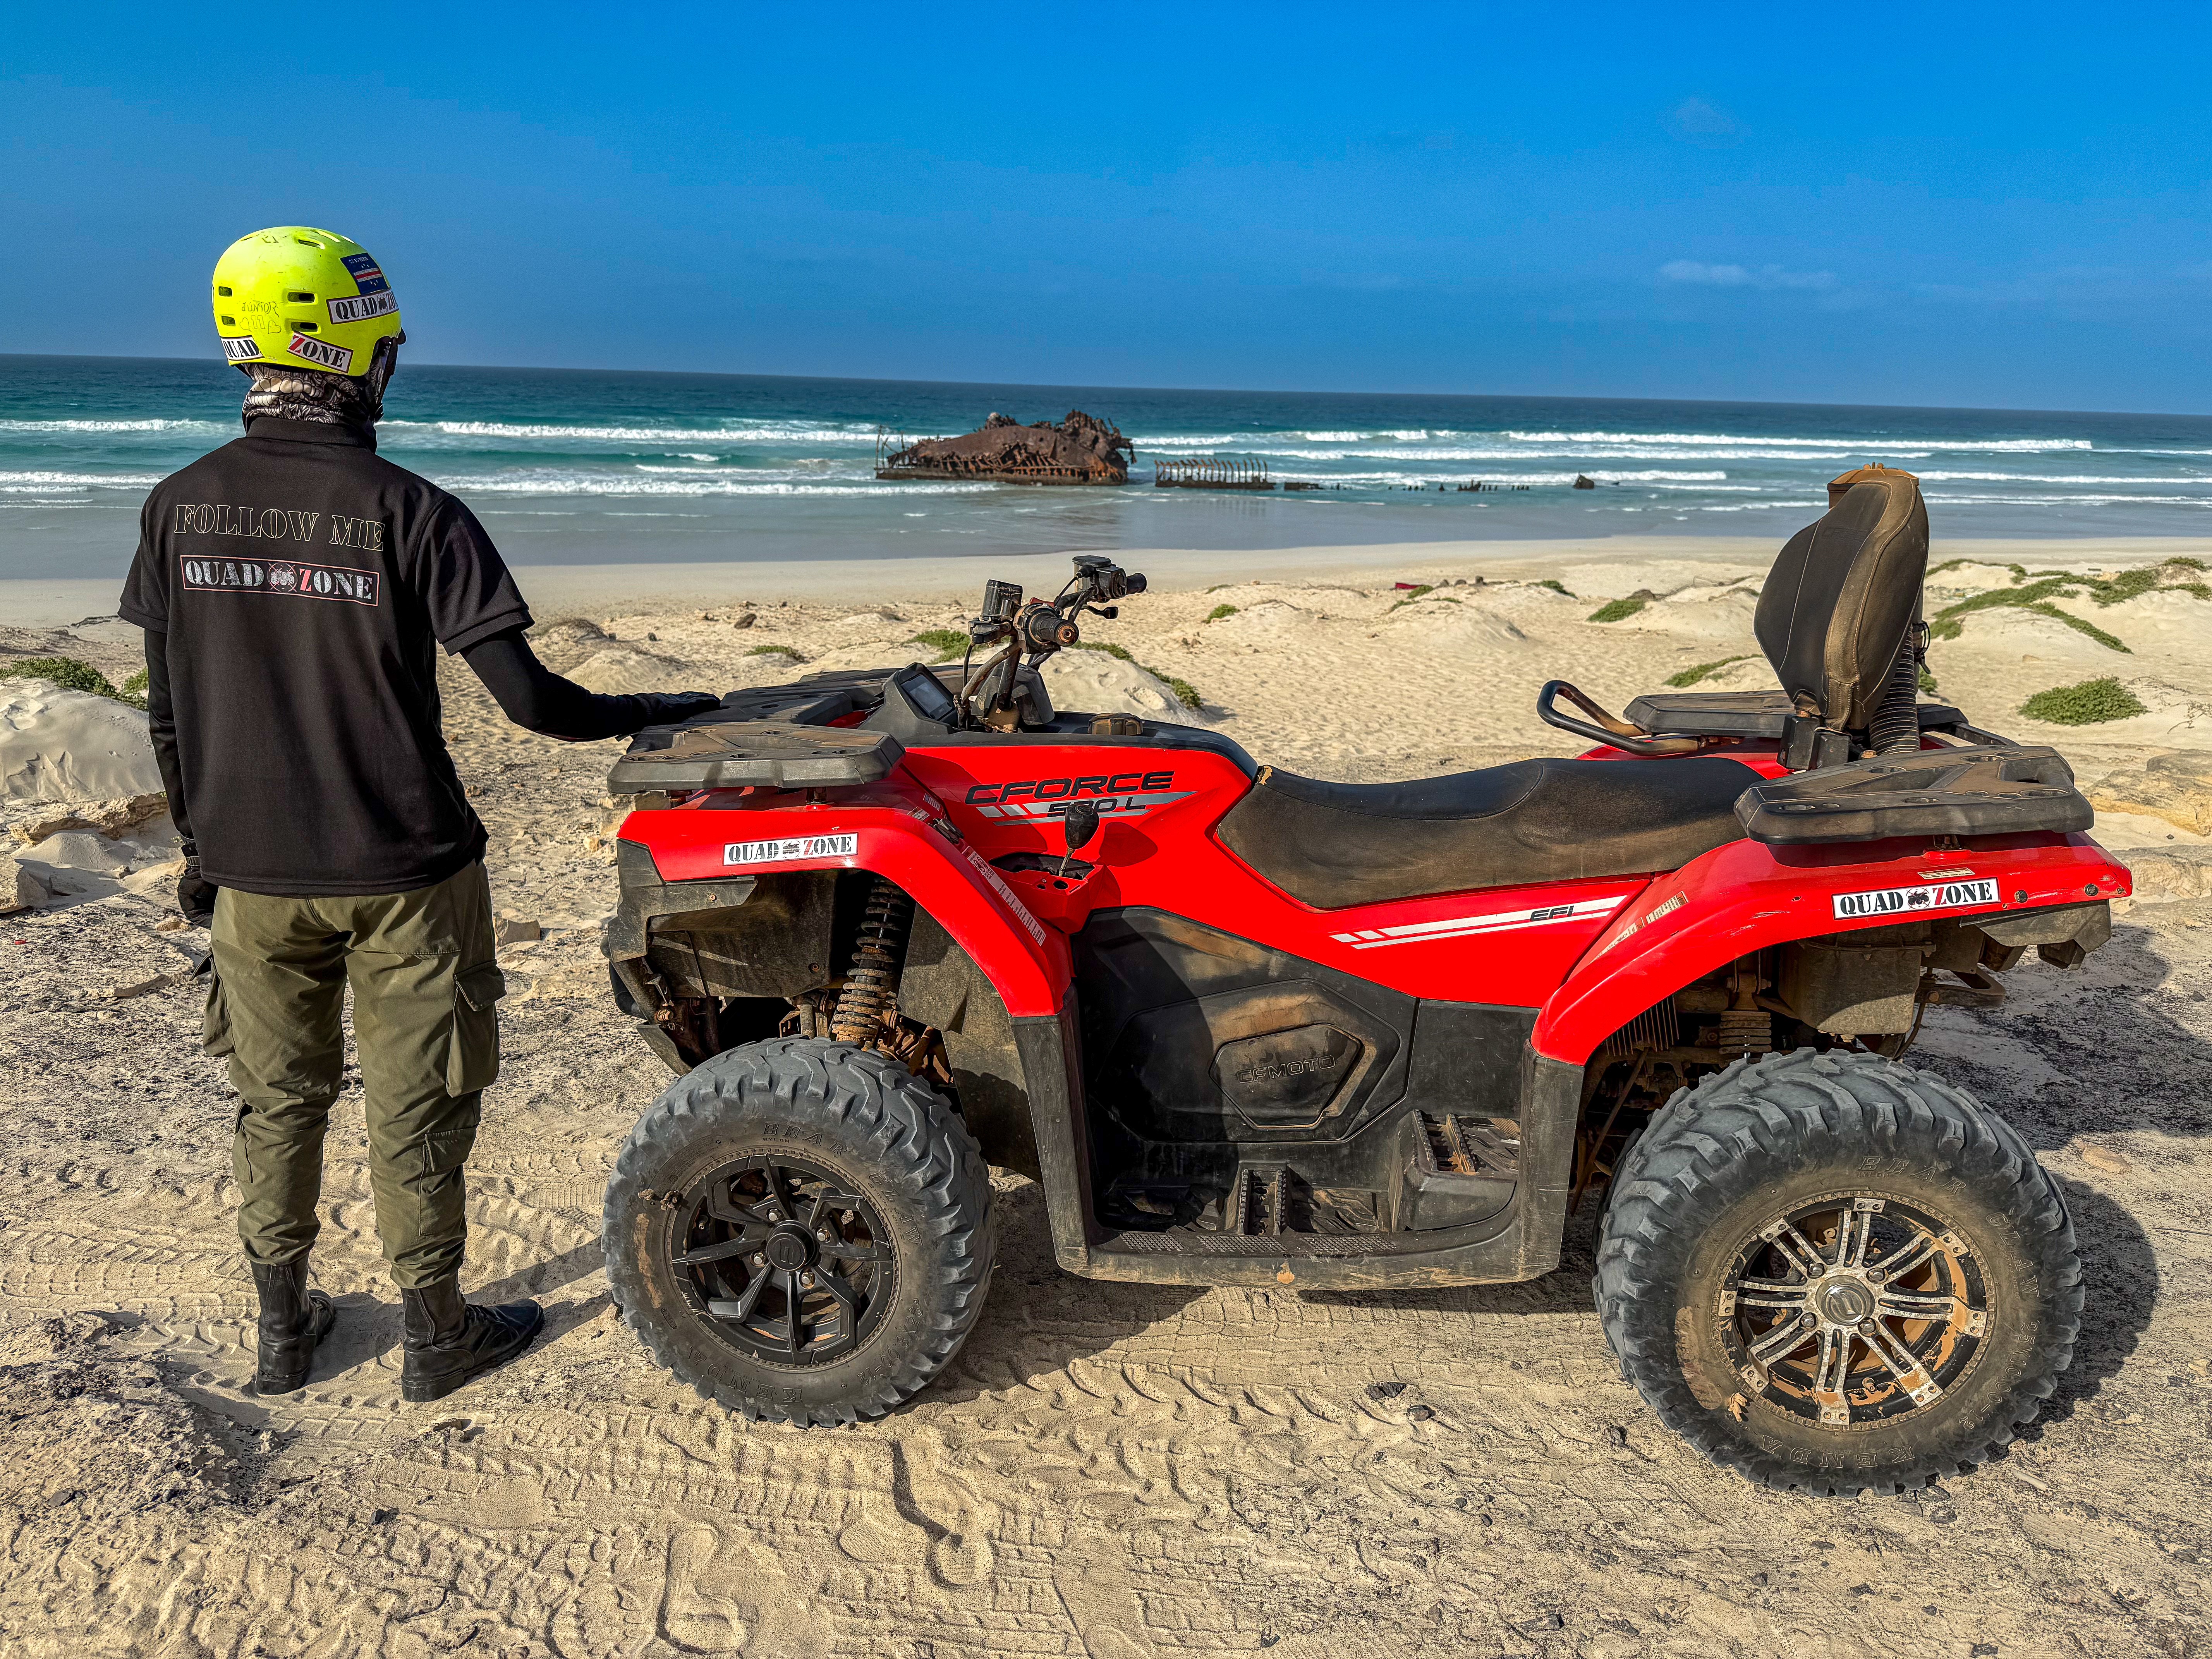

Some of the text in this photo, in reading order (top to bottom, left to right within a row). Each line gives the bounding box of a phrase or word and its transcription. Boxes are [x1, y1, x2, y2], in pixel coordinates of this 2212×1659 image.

[335, 297, 378, 320] QUAD
[223, 339, 259, 358] QUAD
[289, 335, 346, 368] ZONE
[174, 504, 385, 551] FOLLOW ME
[185, 560, 373, 599] QUAD ZONE
[965, 771, 1175, 805] CFORCE
[1125, 797, 1146, 810] L
[729, 836, 852, 862] QUAD ZONE
[1530, 905, 1574, 922] EFI
[1840, 882, 1992, 915] QUAD ZONE
[1237, 1055, 1335, 1083] CFMOTO
[761, 1122, 848, 1157] BEAR
[869, 1172, 924, 1246] CLAW
[1858, 1156, 1966, 1195] BEAR
[1986, 1212, 2040, 1297] CLAW
[688, 1345, 803, 1403] KENDA
[1761, 1434, 1915, 1468] KENDA
